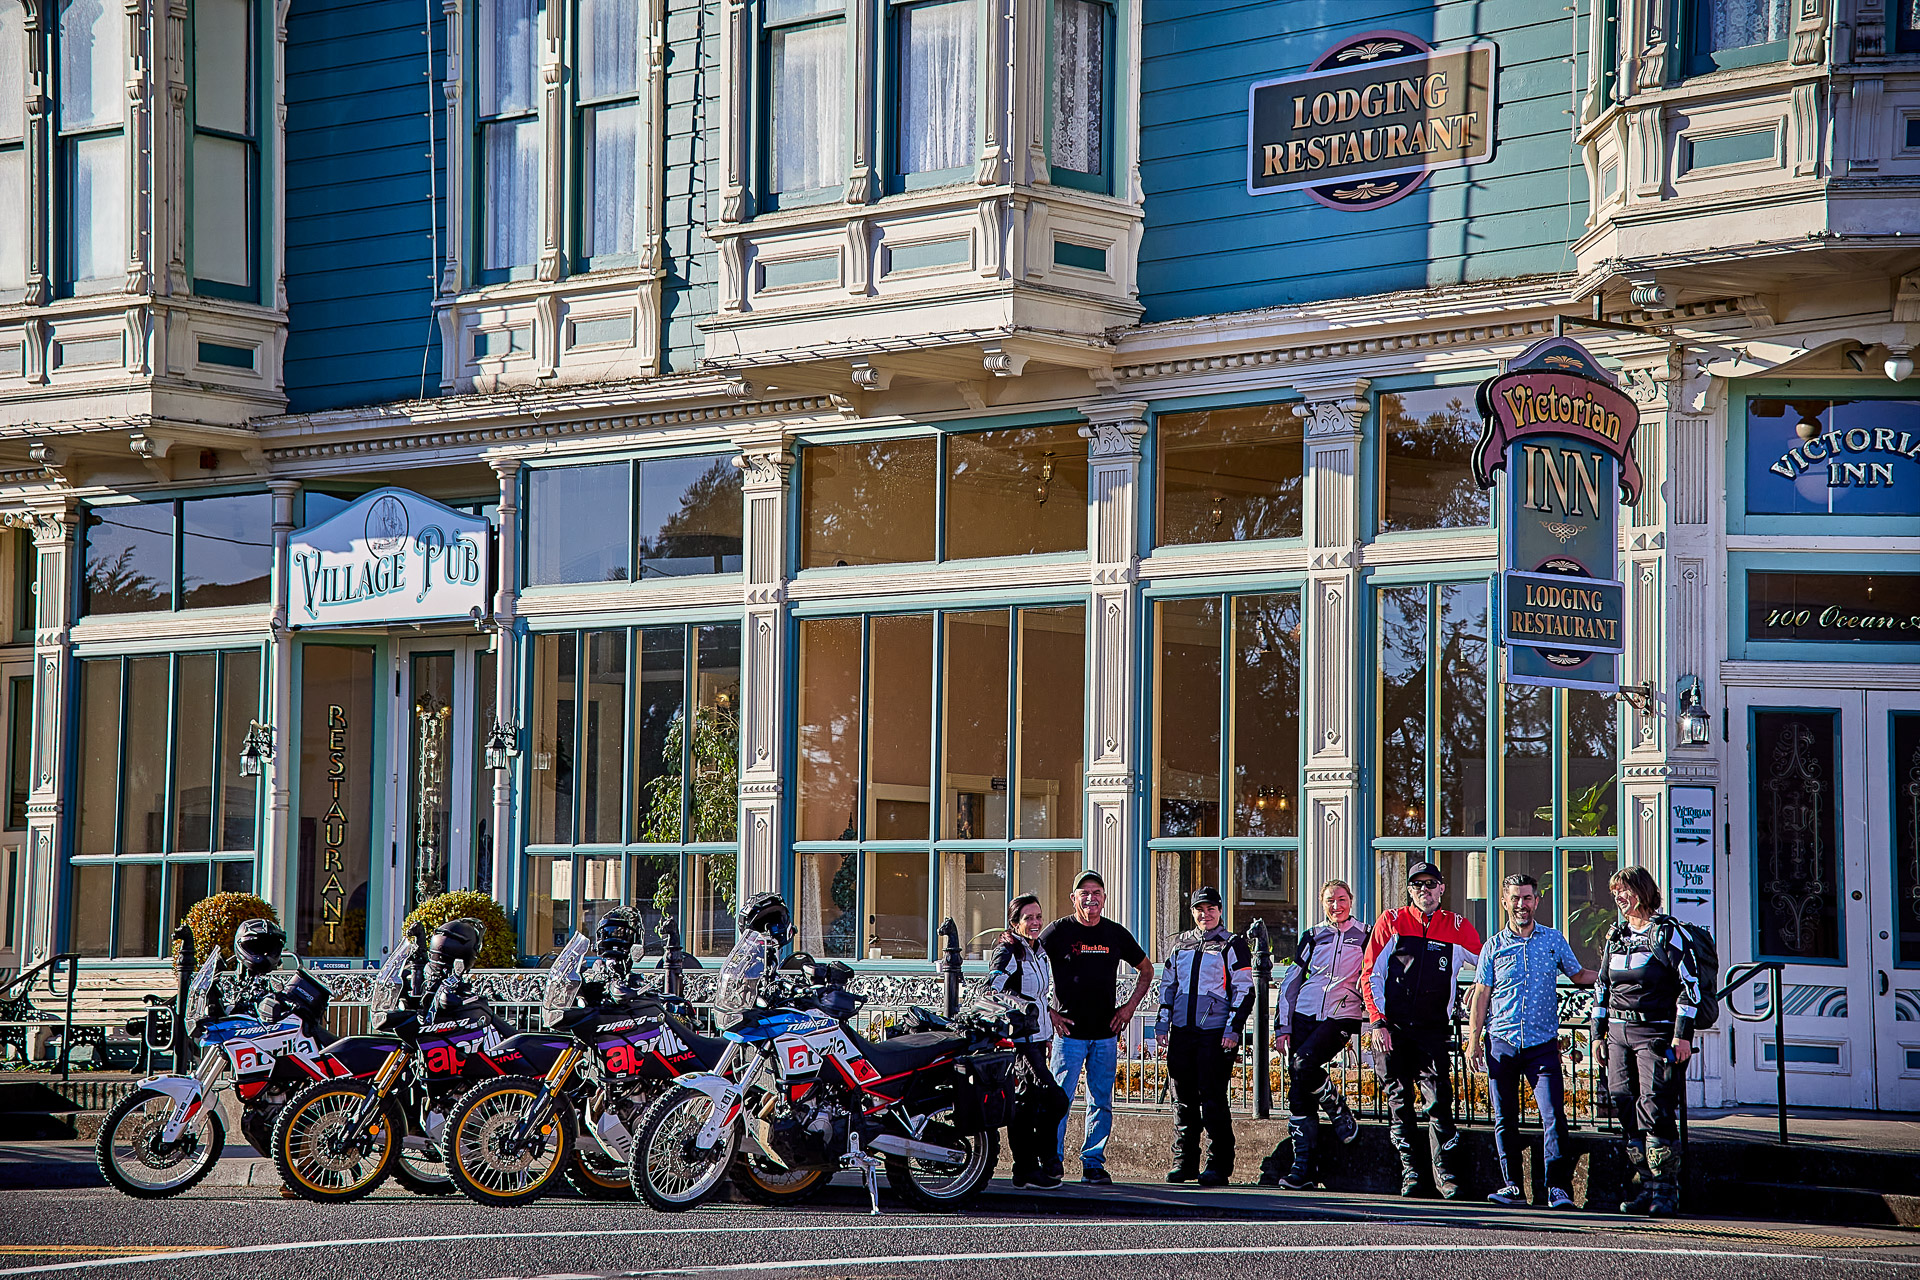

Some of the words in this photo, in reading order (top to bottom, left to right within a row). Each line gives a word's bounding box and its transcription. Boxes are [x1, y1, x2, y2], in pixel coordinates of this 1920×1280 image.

[1292, 71, 1449, 130] LODGING
[1261, 111, 1477, 178] RESTAURANT
[1502, 385, 1621, 443] Victorian
[1523, 445, 1603, 519] INN
[1829, 463, 1894, 485] INN
[295, 549, 406, 619] VILLAGE
[415, 525, 480, 603] PUB
[1525, 584, 1603, 613] LODGING
[1511, 610, 1618, 641] RESTAURANT
[1765, 609, 1811, 628] 400
[1818, 604, 1901, 629] Ocean
[320, 704, 349, 944] RESTAURANT
[1682, 815, 1694, 827] INN
[1673, 860, 1711, 876] VILLAGE
[1681, 872, 1704, 888] PUB
[1098, 944, 1110, 954] Dog
